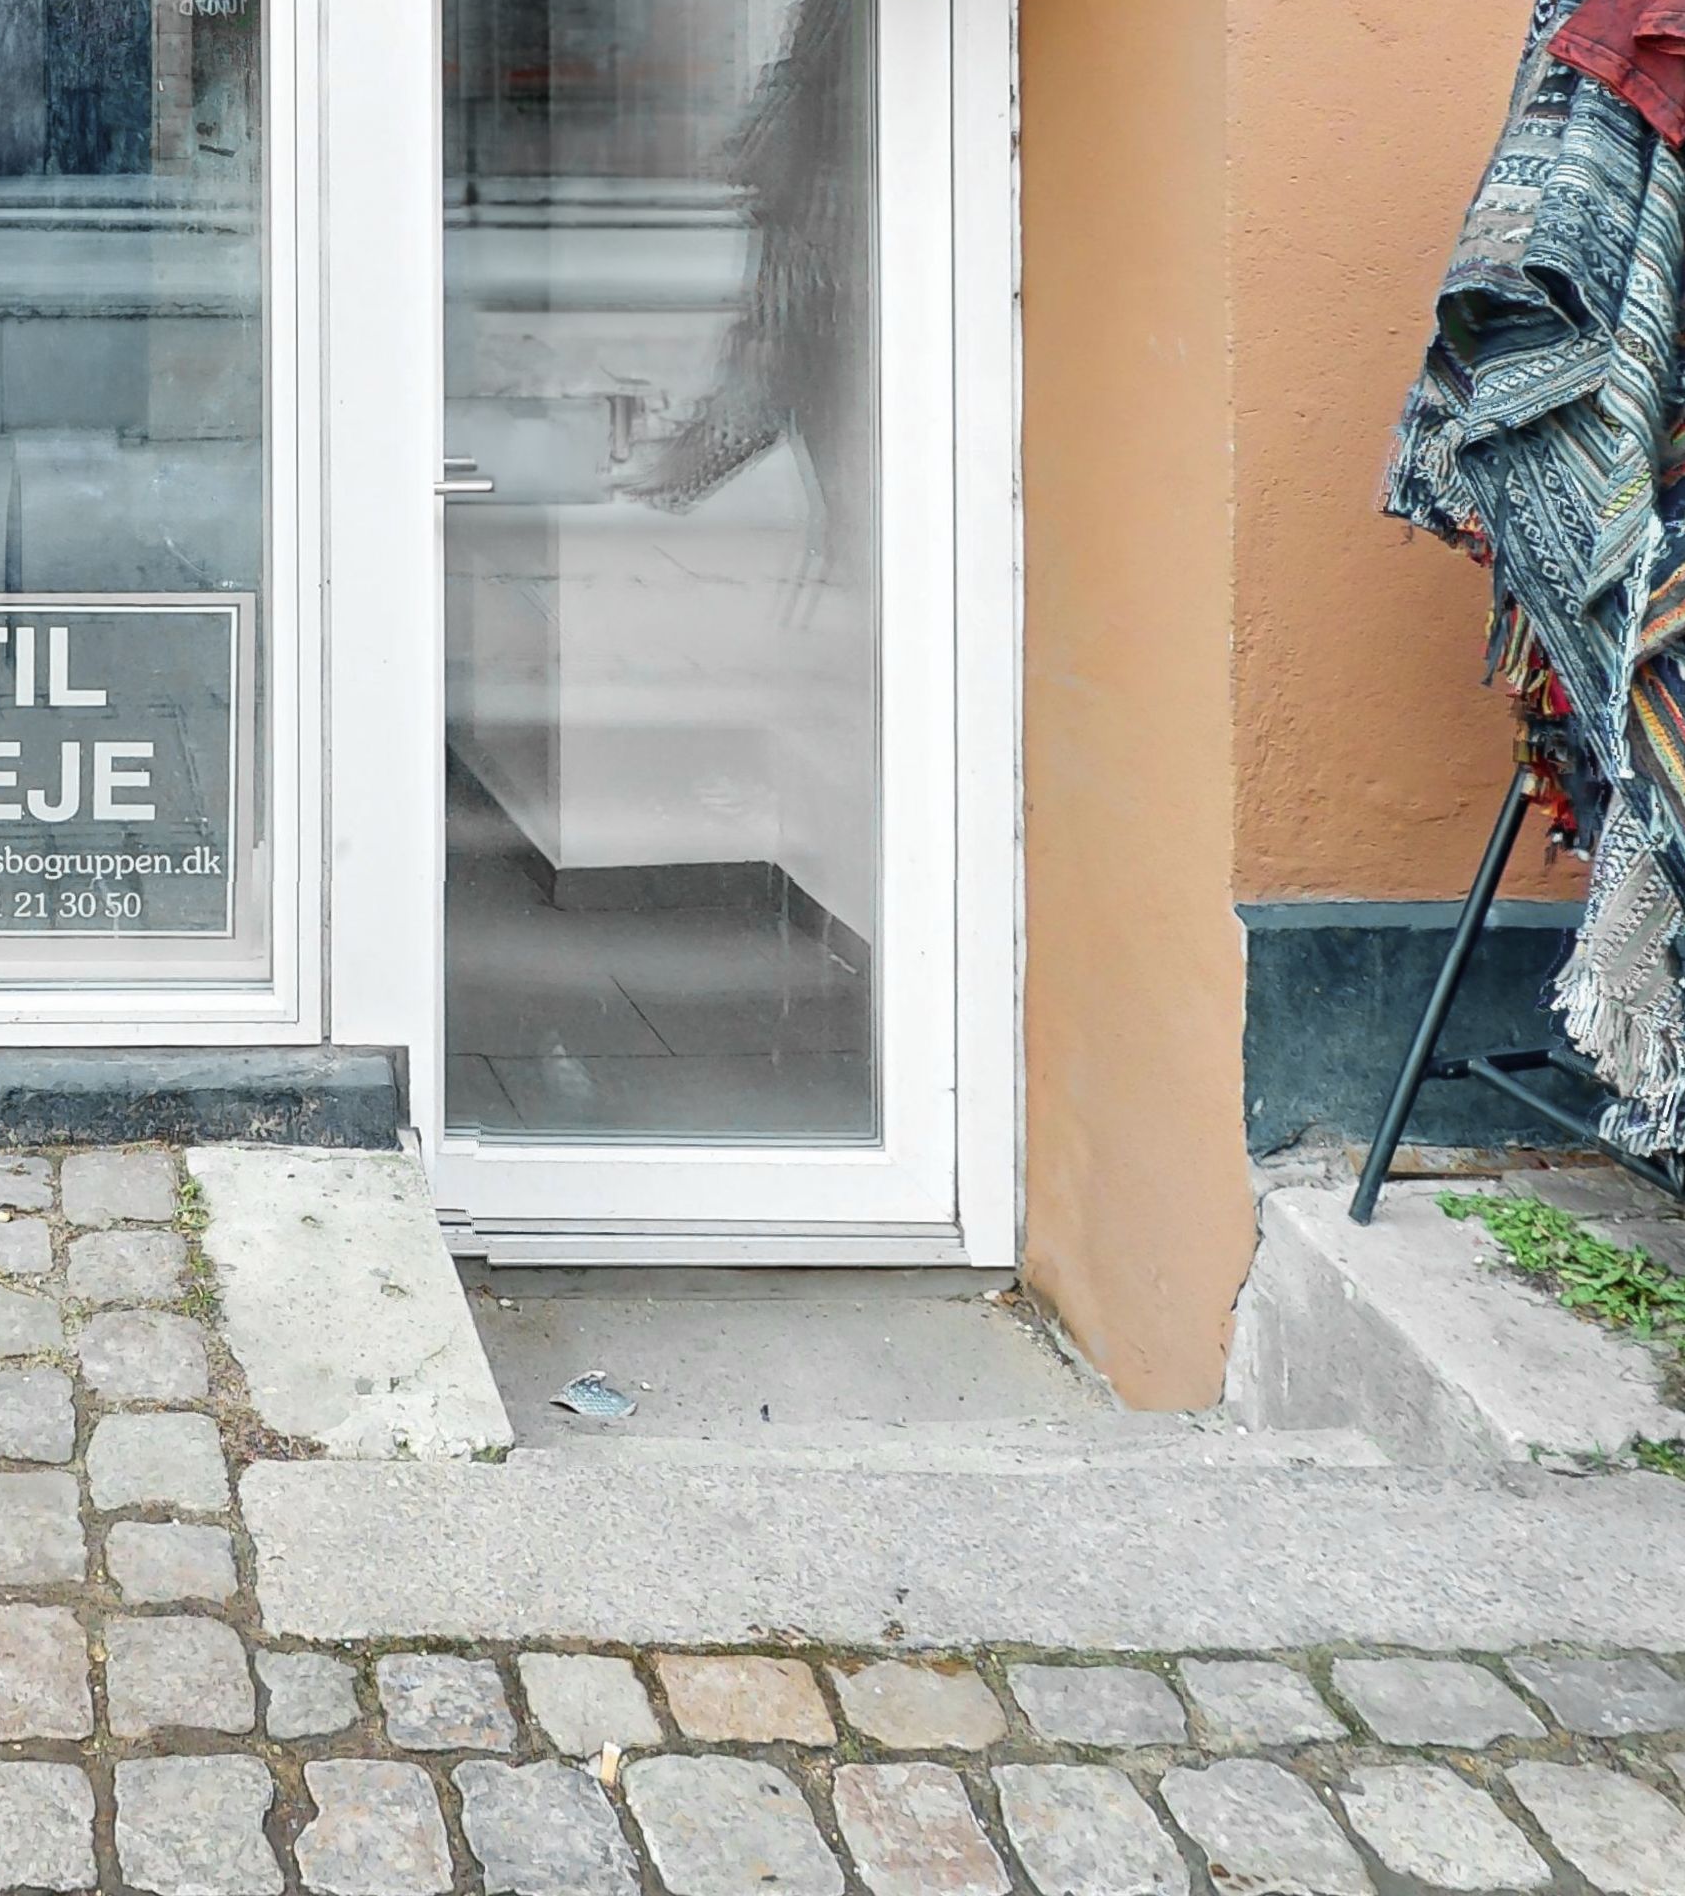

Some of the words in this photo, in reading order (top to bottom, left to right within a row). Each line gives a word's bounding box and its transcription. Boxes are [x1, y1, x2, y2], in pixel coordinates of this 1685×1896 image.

[14, 891, 48, 918] 21
[59, 891, 96, 918] 30
[105, 891, 142, 918] 50
